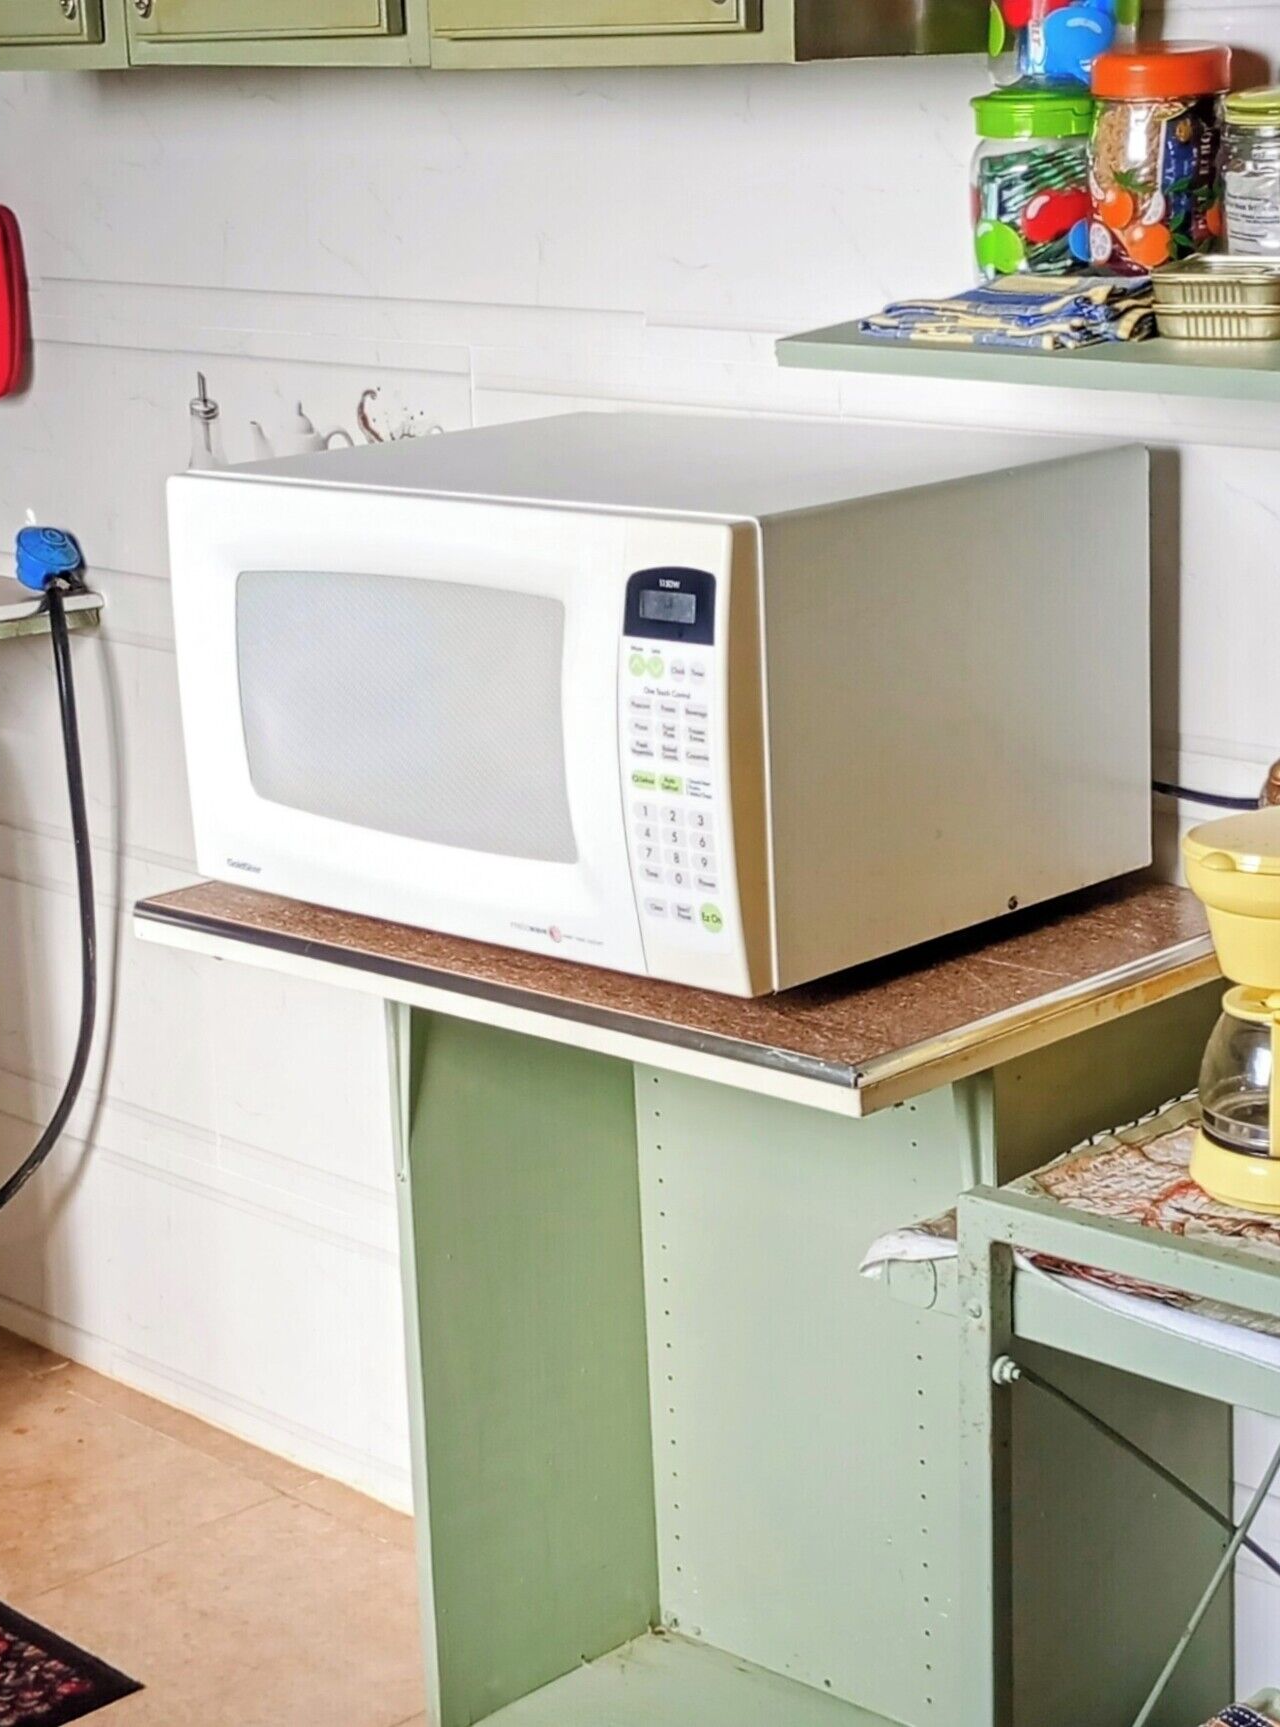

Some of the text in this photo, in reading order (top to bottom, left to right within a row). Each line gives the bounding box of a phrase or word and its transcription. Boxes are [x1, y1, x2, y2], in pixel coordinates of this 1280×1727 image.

[643, 686, 691, 699] One Touch Control
[643, 805, 648, 817] 1
[669, 810, 676, 822] 2
[697, 815, 704, 826] 3
[644, 827, 651, 838] 4
[671, 831, 678, 843] 5
[699, 837, 706, 848] 6
[645, 847, 652, 858] 7
[673, 852, 680, 864] 8
[700, 856, 708, 868] 9
[675, 872, 682, 884] 0
[711, 913, 722, 924] On
